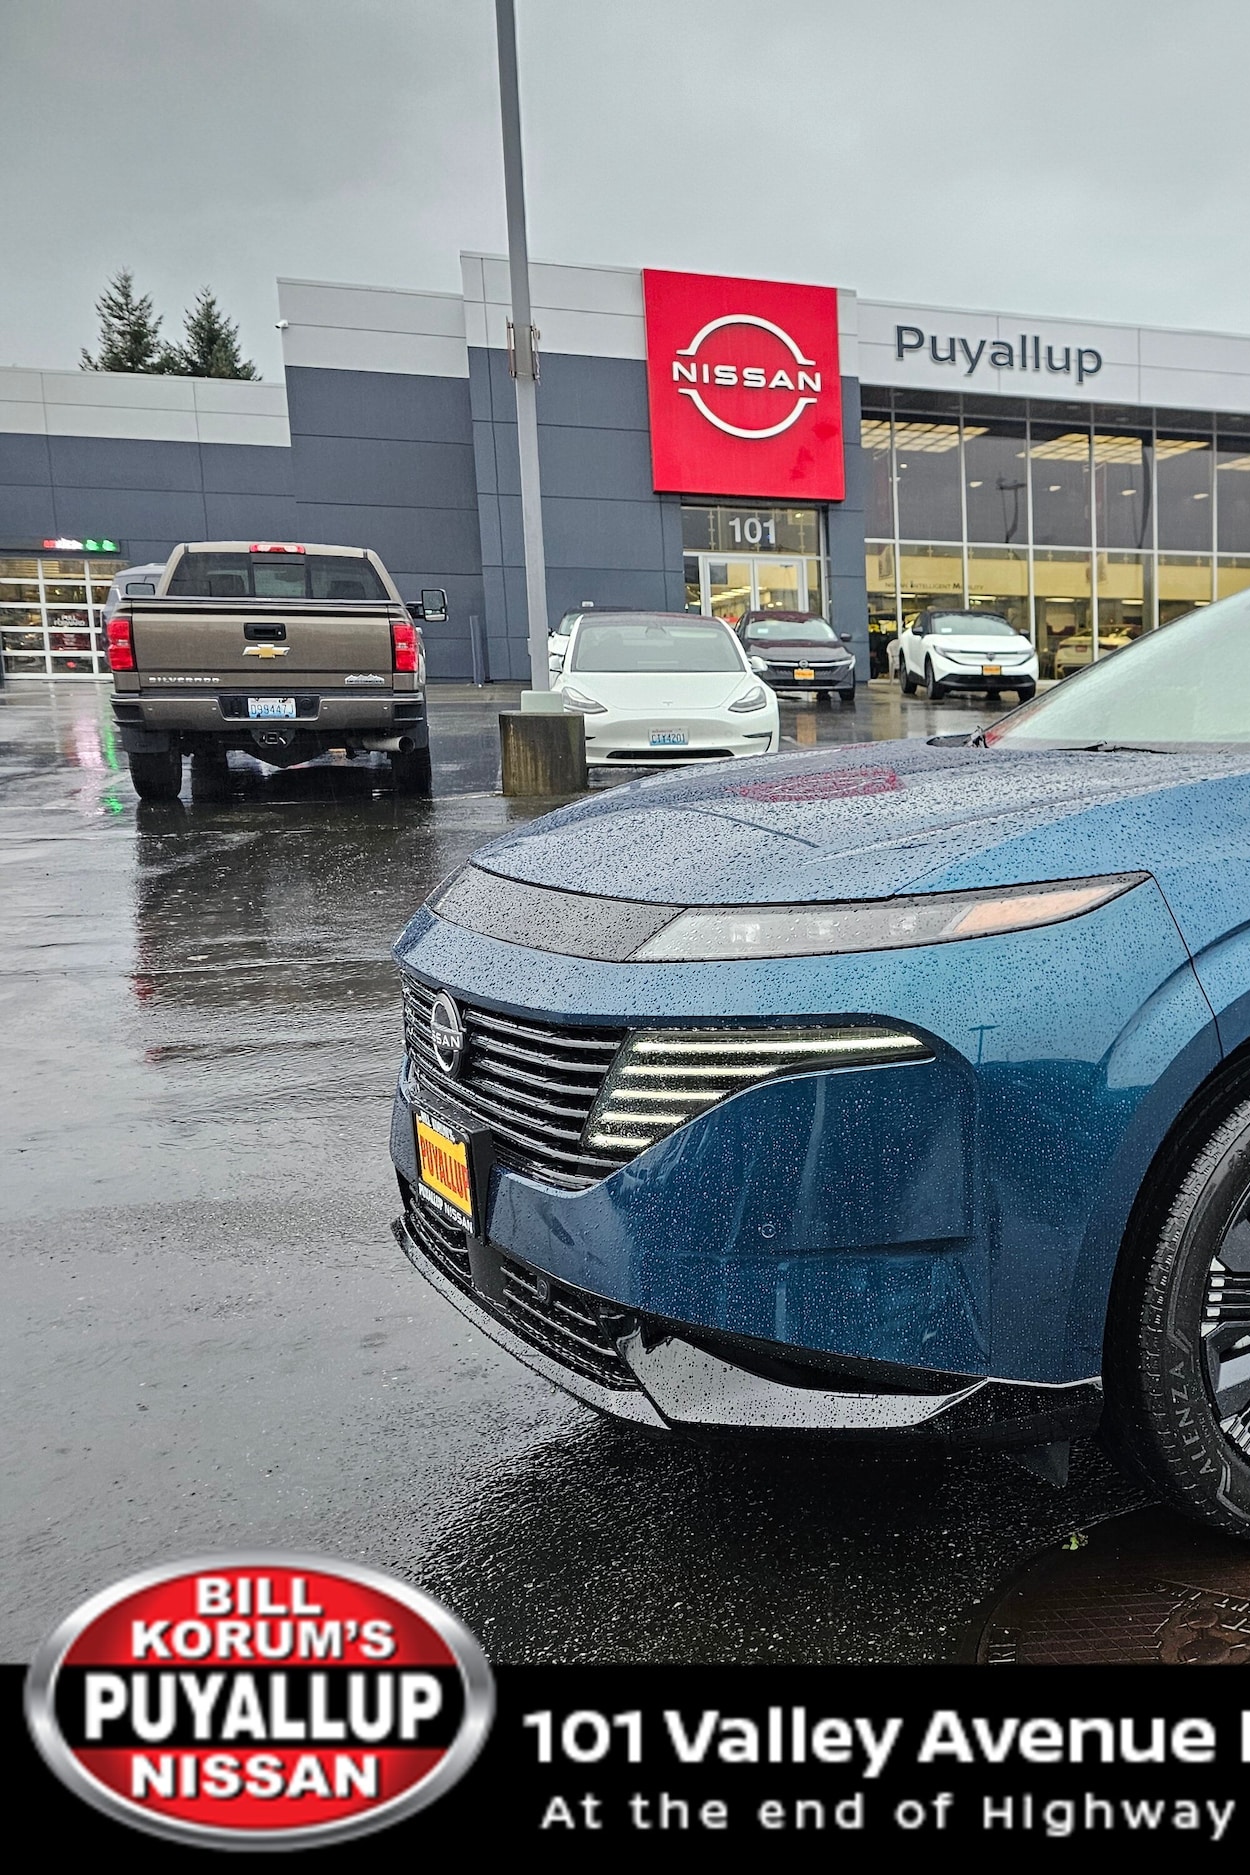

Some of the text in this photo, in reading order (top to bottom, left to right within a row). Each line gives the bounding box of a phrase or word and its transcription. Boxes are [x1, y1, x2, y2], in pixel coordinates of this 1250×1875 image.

[672, 360, 822, 393] NISSAN
[895, 324, 1104, 385] Puyallup
[729, 517, 776, 545] 101
[1169, 1361, 1218, 1474] ALENZA
